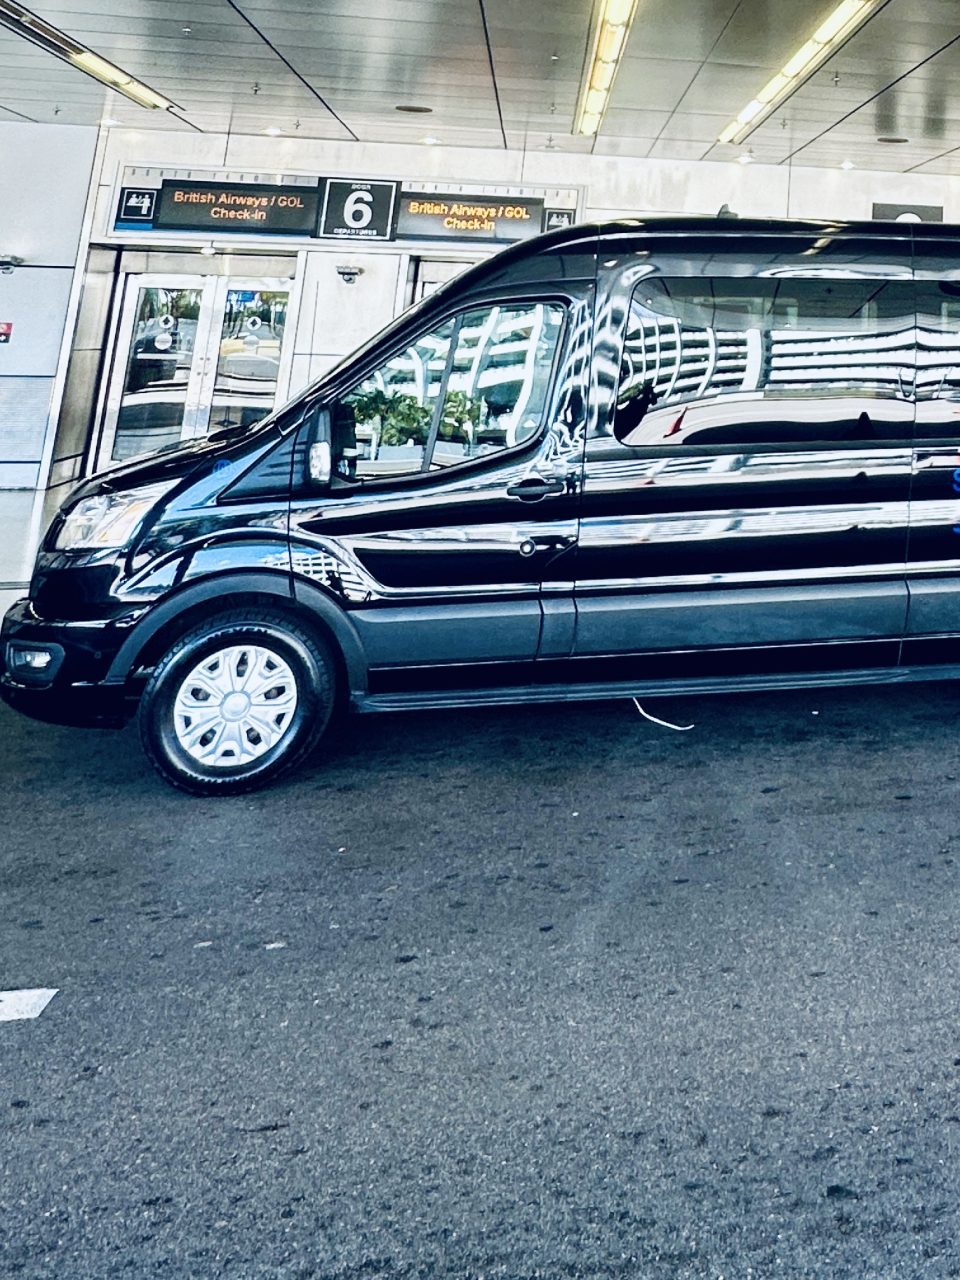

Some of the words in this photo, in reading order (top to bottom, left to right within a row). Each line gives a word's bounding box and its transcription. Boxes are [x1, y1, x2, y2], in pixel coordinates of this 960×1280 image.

[174, 191, 215, 204] British
[218, 193, 267, 207] Airways
[277, 196, 304, 208] GOL
[343, 190, 374, 229] 6
[409, 201, 447, 215] British
[449, 203, 496, 218] Airways
[504, 206, 530, 219] GOL
